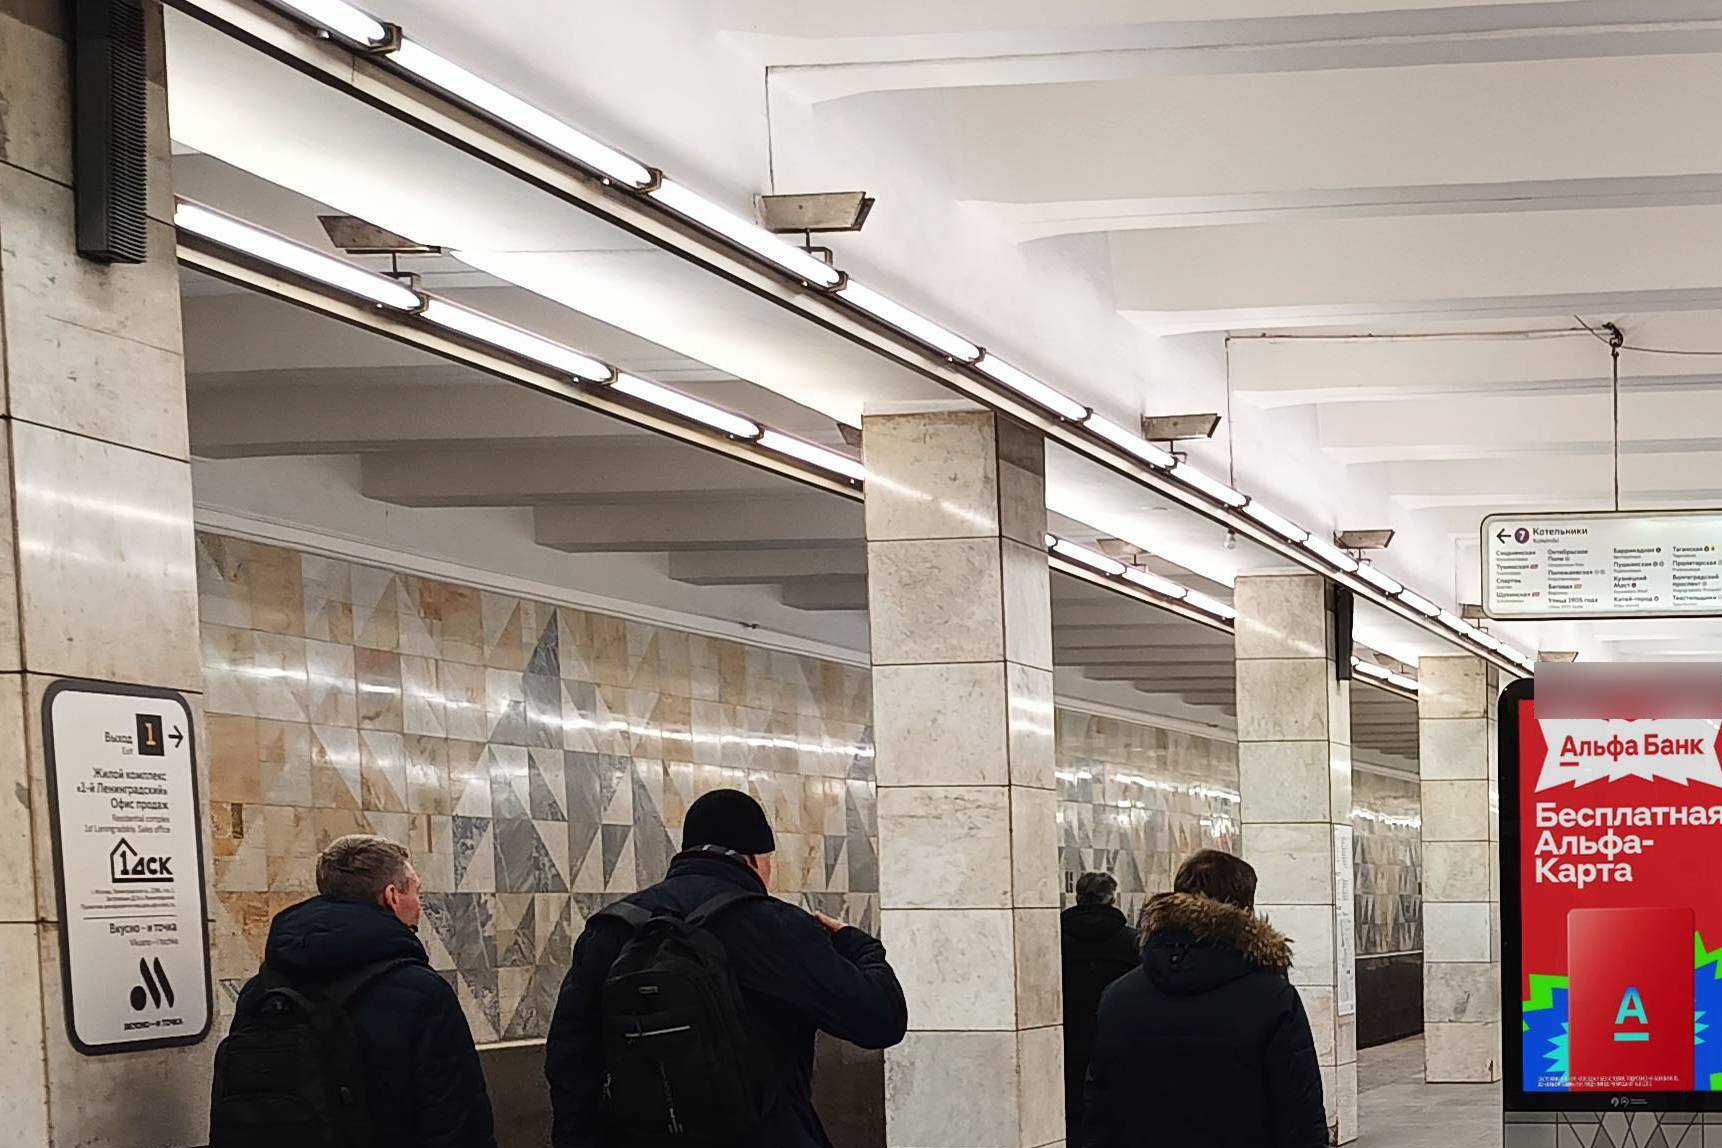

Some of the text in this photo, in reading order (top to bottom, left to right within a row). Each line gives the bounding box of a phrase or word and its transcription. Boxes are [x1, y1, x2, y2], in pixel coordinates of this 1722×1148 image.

[1533, 528, 1588, 536] Котельники
[104, 722, 156, 745] Выход 1
[1560, 734, 1704, 762] Альфа Банк
[92, 767, 167, 781] Жилой комплекс
[110, 797, 169, 811] Офис продаж
[1534, 828, 1654, 861] Альфа-
[1535, 857, 1633, 889] Карта
[109, 923, 141, 937] Вкусно
[153, 922, 178, 932] точка
